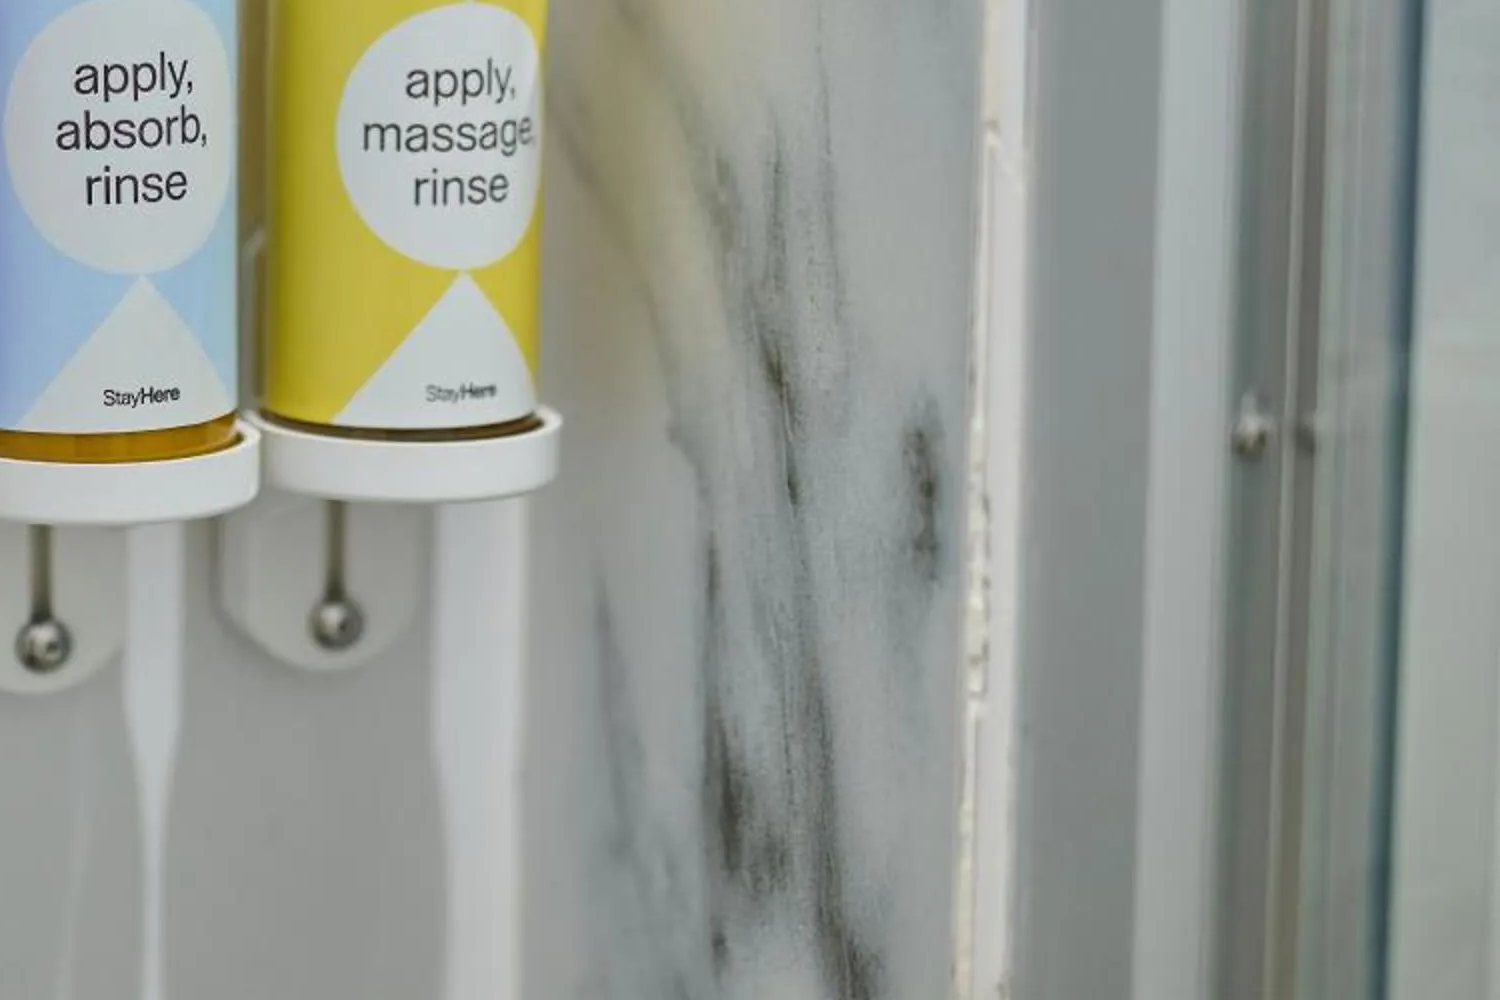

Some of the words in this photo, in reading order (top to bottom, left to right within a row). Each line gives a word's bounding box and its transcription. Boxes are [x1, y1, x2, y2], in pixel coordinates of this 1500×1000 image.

[73, 50, 193, 102] apply,
[405, 57, 516, 107] apply,
[56, 104, 207, 151] absorb,
[85, 165, 188, 206] rinse
[414, 167, 510, 206] rinse
[103, 386, 181, 408] StayHere
